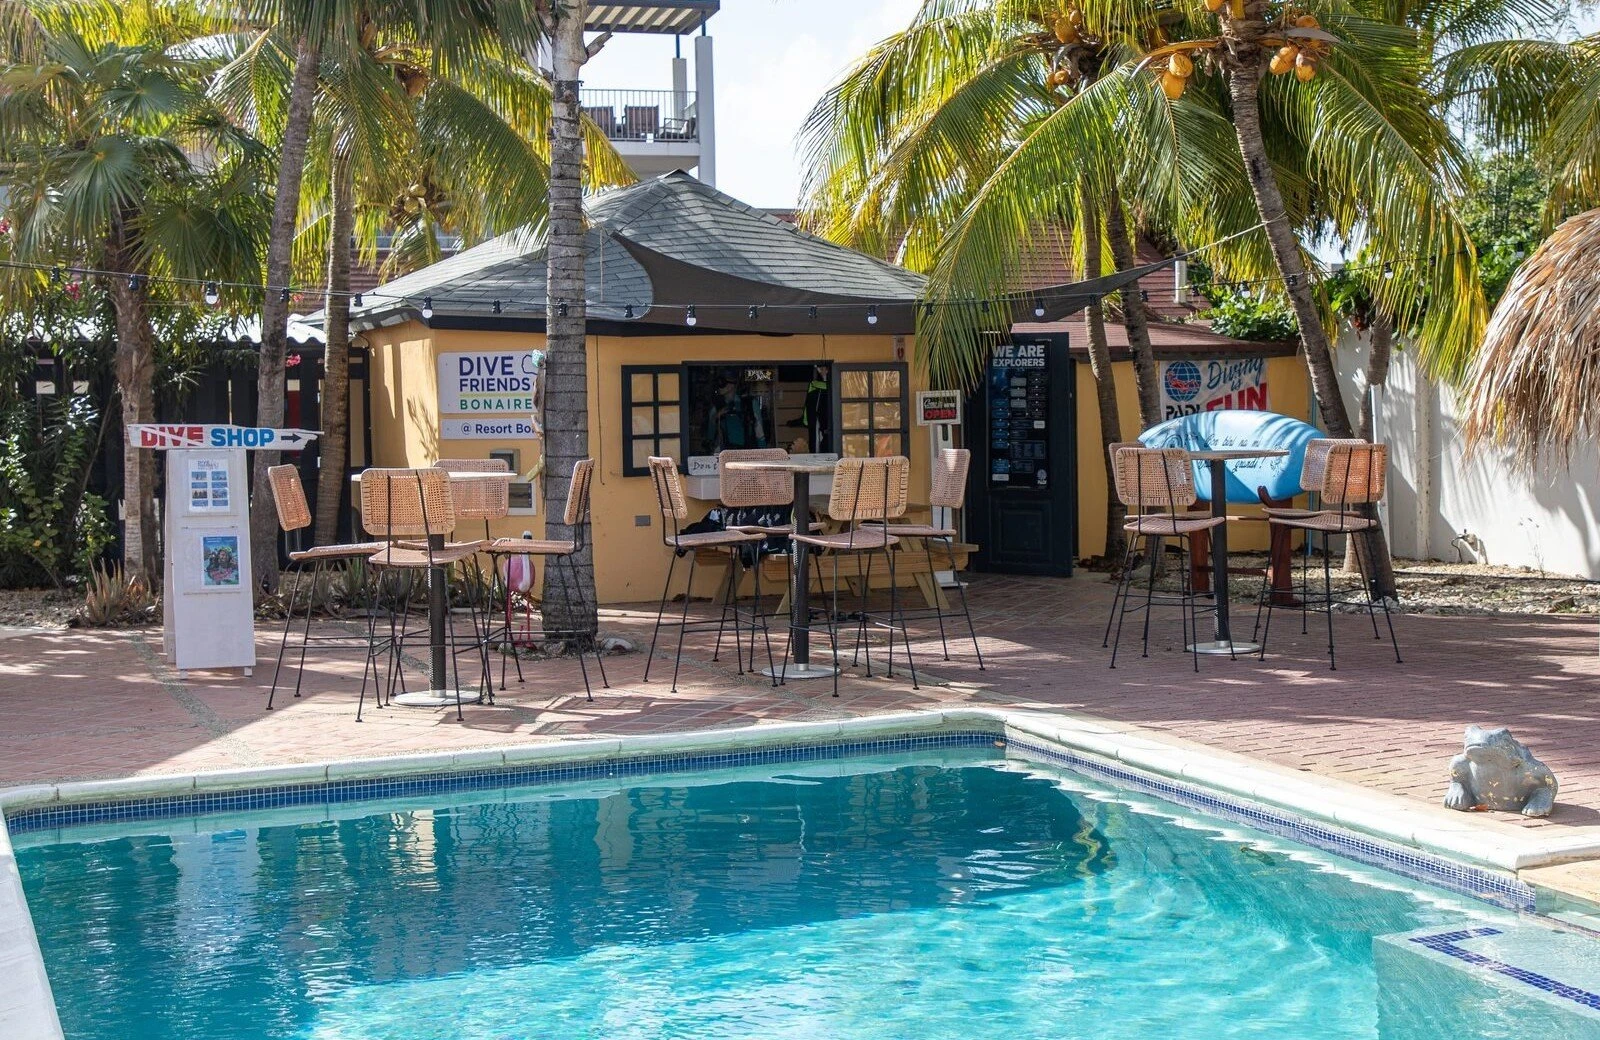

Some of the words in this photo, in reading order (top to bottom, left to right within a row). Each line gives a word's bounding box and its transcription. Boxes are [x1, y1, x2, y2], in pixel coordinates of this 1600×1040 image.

[993, 345, 1014, 358] WE
[1017, 345, 1045, 358] ARE
[459, 356, 514, 376] DIVE
[992, 358, 1045, 367] EXPLORERS
[1207, 354, 1264, 389] Diving
[459, 377, 531, 392] FRIENDS
[459, 398, 532, 410] BONAIRE
[925, 409, 956, 419] OPEN
[475, 423, 512, 434] Resort
[516, 423, 534, 434] Bo
[141, 426, 204, 447] DIVE
[210, 428, 275, 447] SHOP
